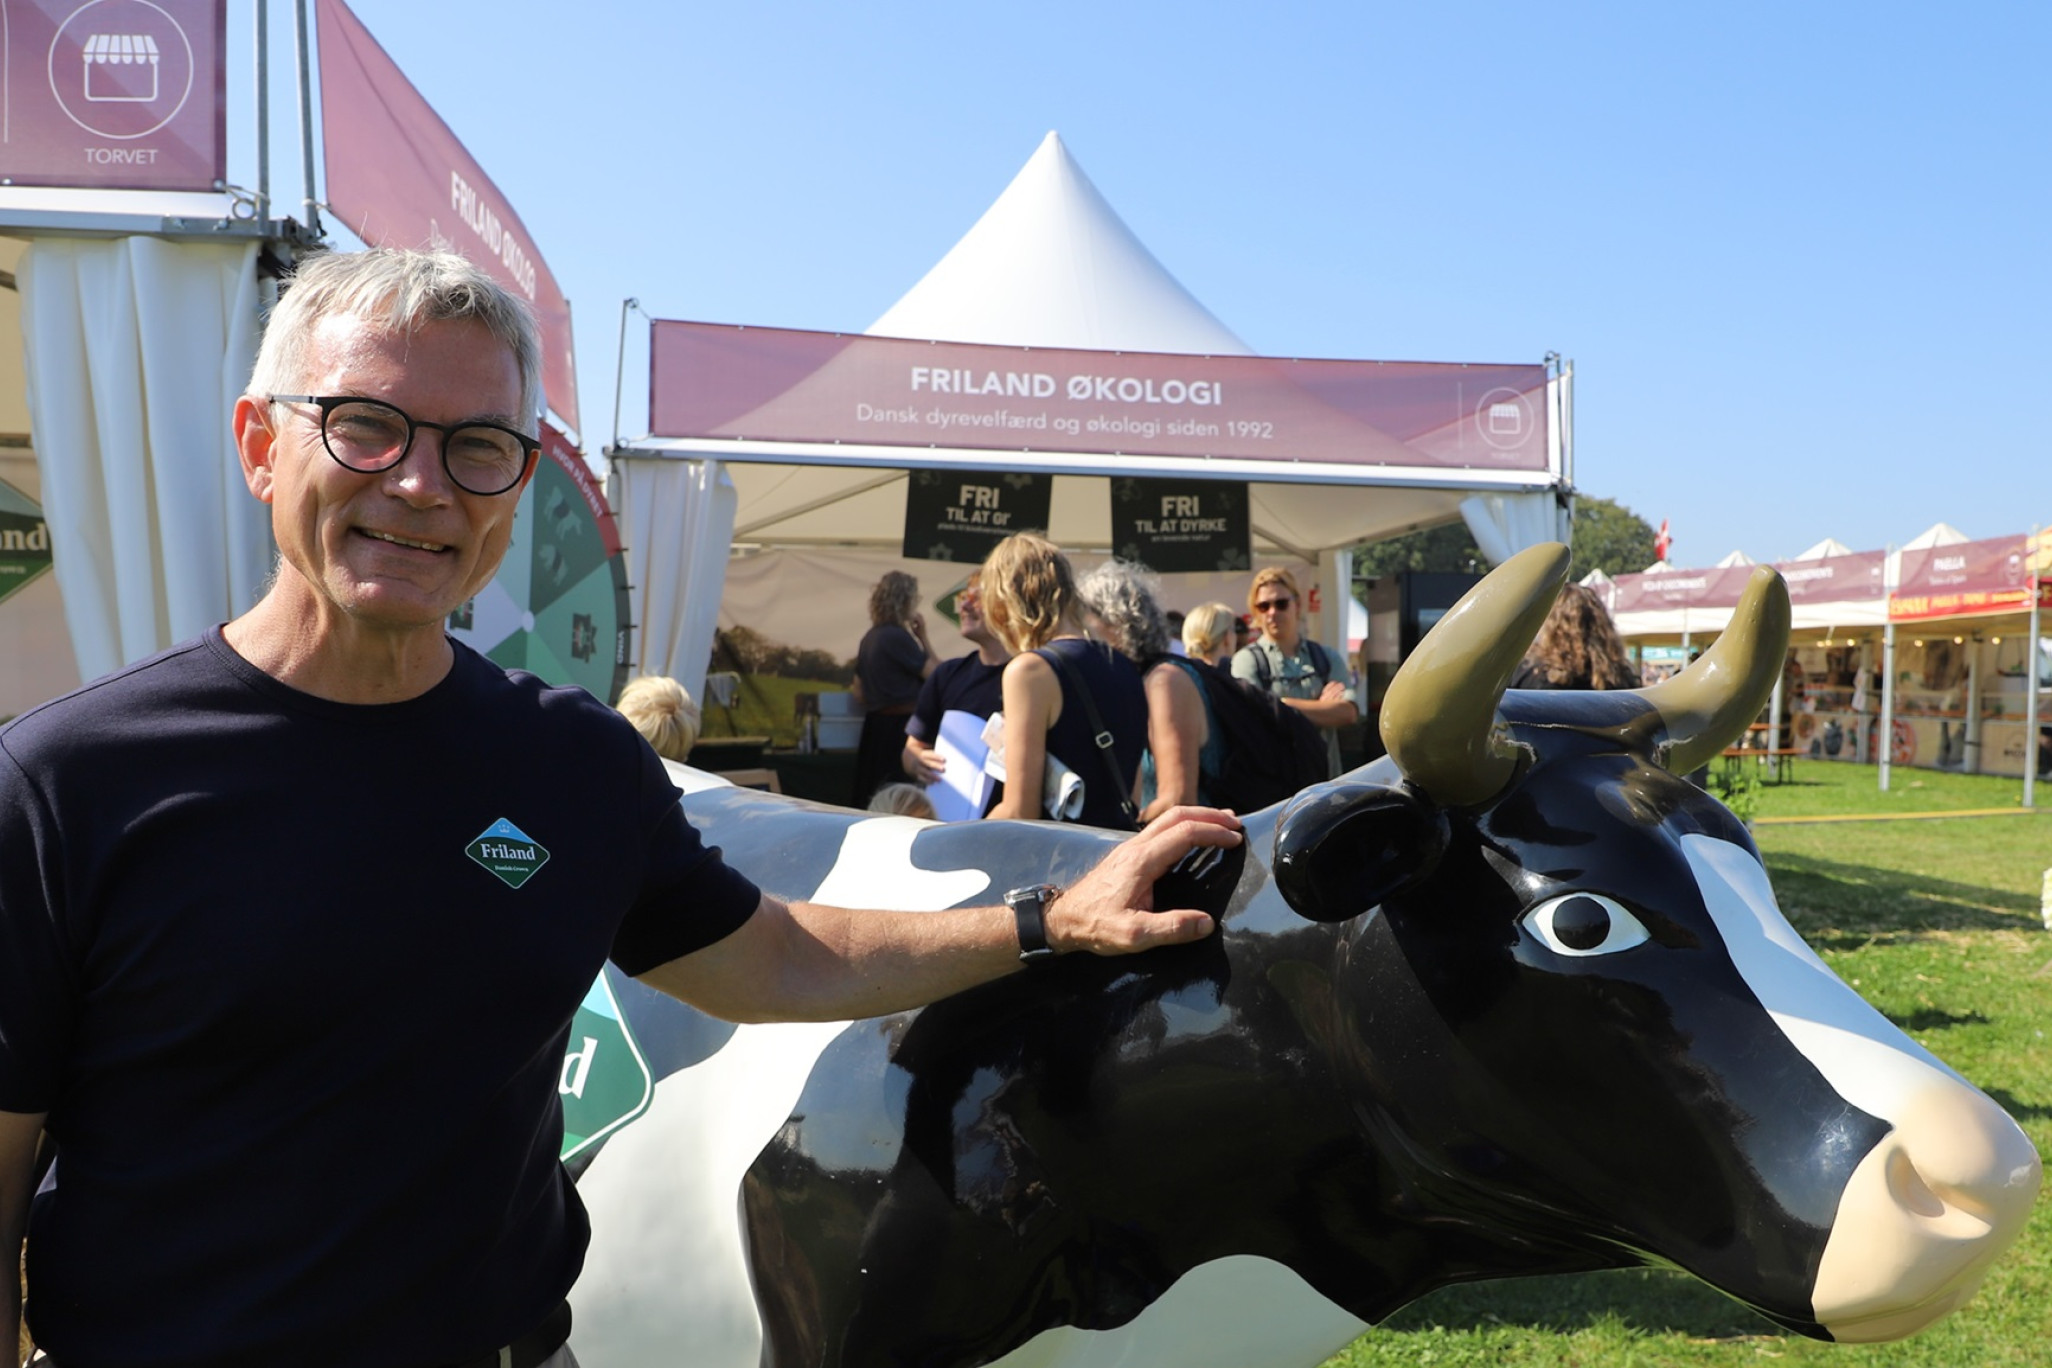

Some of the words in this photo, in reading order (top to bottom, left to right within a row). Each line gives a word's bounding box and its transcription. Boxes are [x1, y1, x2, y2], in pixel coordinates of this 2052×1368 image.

[84, 148, 158, 164] TORVET
[451, 170, 502, 255] FRILAND
[910, 366, 1056, 398] FRILAND
[1067, 374, 1222, 406] ØKOLOGI
[856, 403, 919, 424] Dansk
[926, 407, 1047, 430] dyrevelfærd
[1053, 417, 1080, 436] og
[1086, 414, 1161, 439] økologi
[1166, 418, 1220, 437] siden
[1227, 420, 1274, 439] 1992
[959, 484, 1000, 510] FRI
[1161, 494, 1200, 518] FRI
[945, 506, 969, 523] TIL
[970, 509, 991, 525] AT
[1135, 519, 1157, 534] TIL
[1159, 518, 1179, 533] AT
[1180, 517, 1227, 533] DYRKE
[480, 843, 536, 861] Friland
